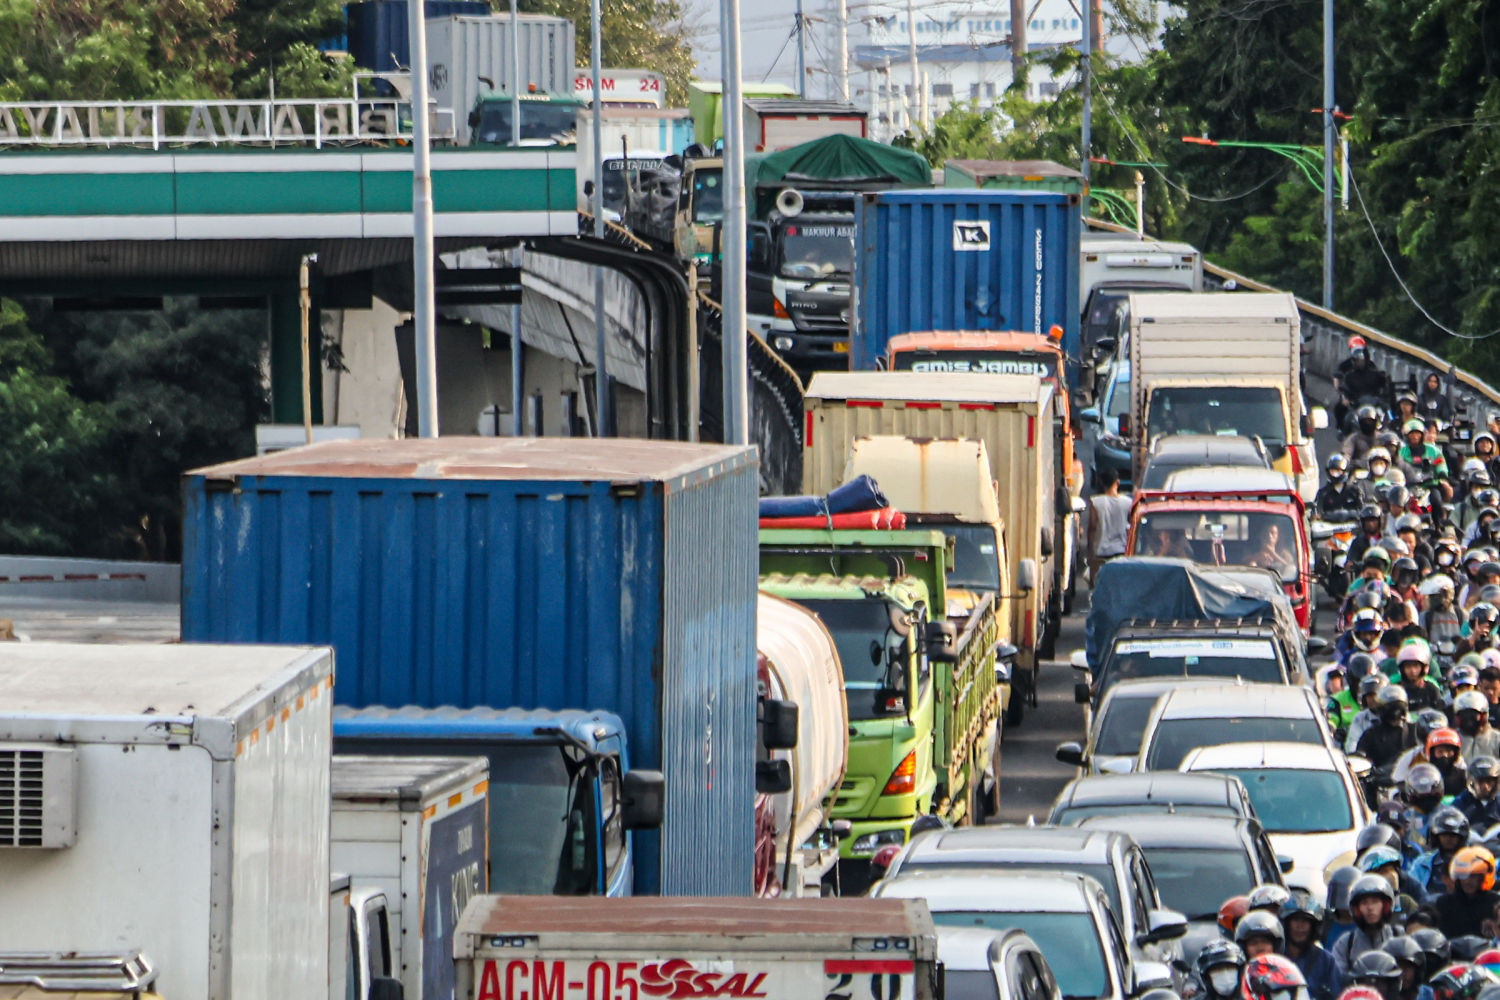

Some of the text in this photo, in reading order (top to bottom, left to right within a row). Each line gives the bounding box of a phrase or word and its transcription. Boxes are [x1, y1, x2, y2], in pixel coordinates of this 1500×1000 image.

[639, 78, 660, 92] 24
[802, 226, 836, 238] MAKMUR
[790, 301, 818, 310] HINO
